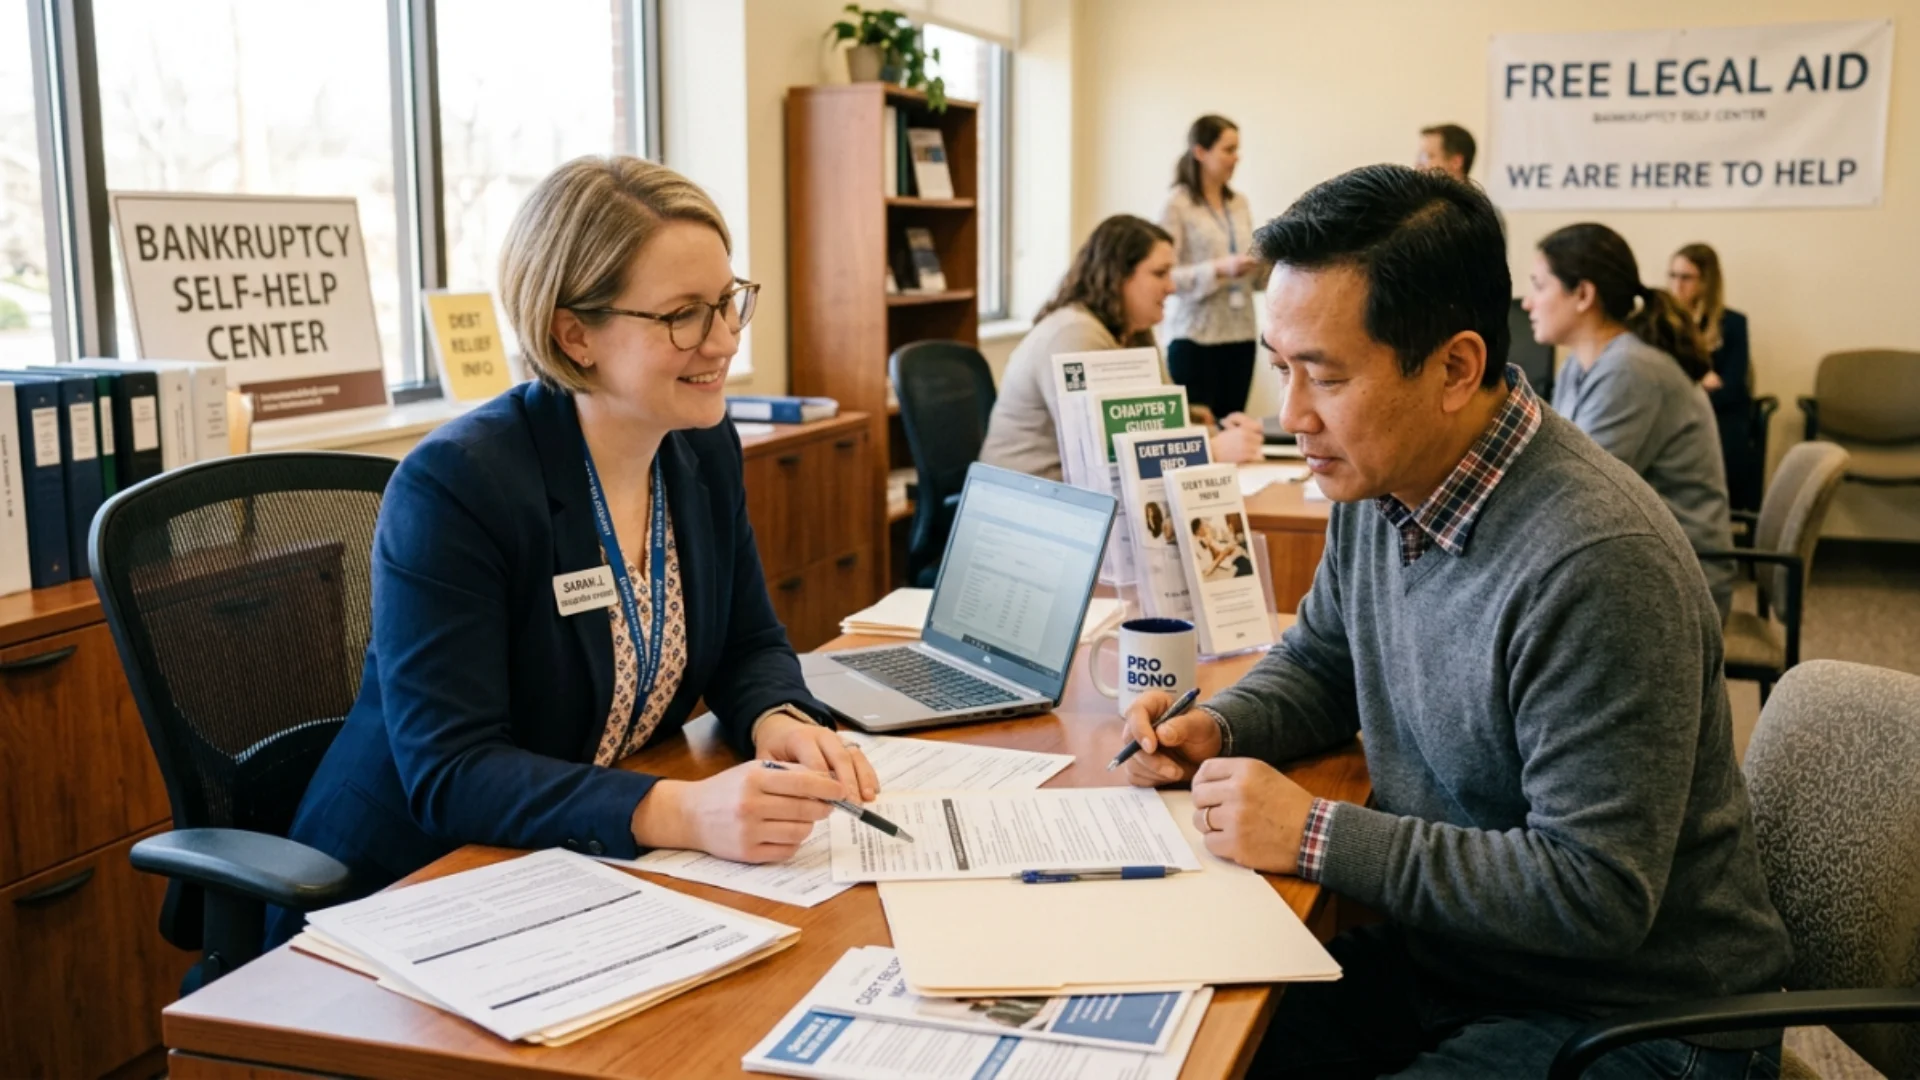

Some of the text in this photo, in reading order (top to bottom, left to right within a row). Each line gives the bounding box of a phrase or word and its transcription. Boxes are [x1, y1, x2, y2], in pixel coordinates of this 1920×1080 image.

[1504, 52, 1869, 99] FREE LEGAL AID
[1507, 158, 1857, 189] WE ARE HERE TO HELP
[135, 223, 351, 262] BANKRUPTCY
[173, 271, 337, 313] SELF-HELP
[207, 318, 328, 361] CENTER
[1109, 401, 1177, 419] CHAPTER 7
[1127, 655, 1161, 671] PRO
[1127, 670, 1177, 687] BONO
